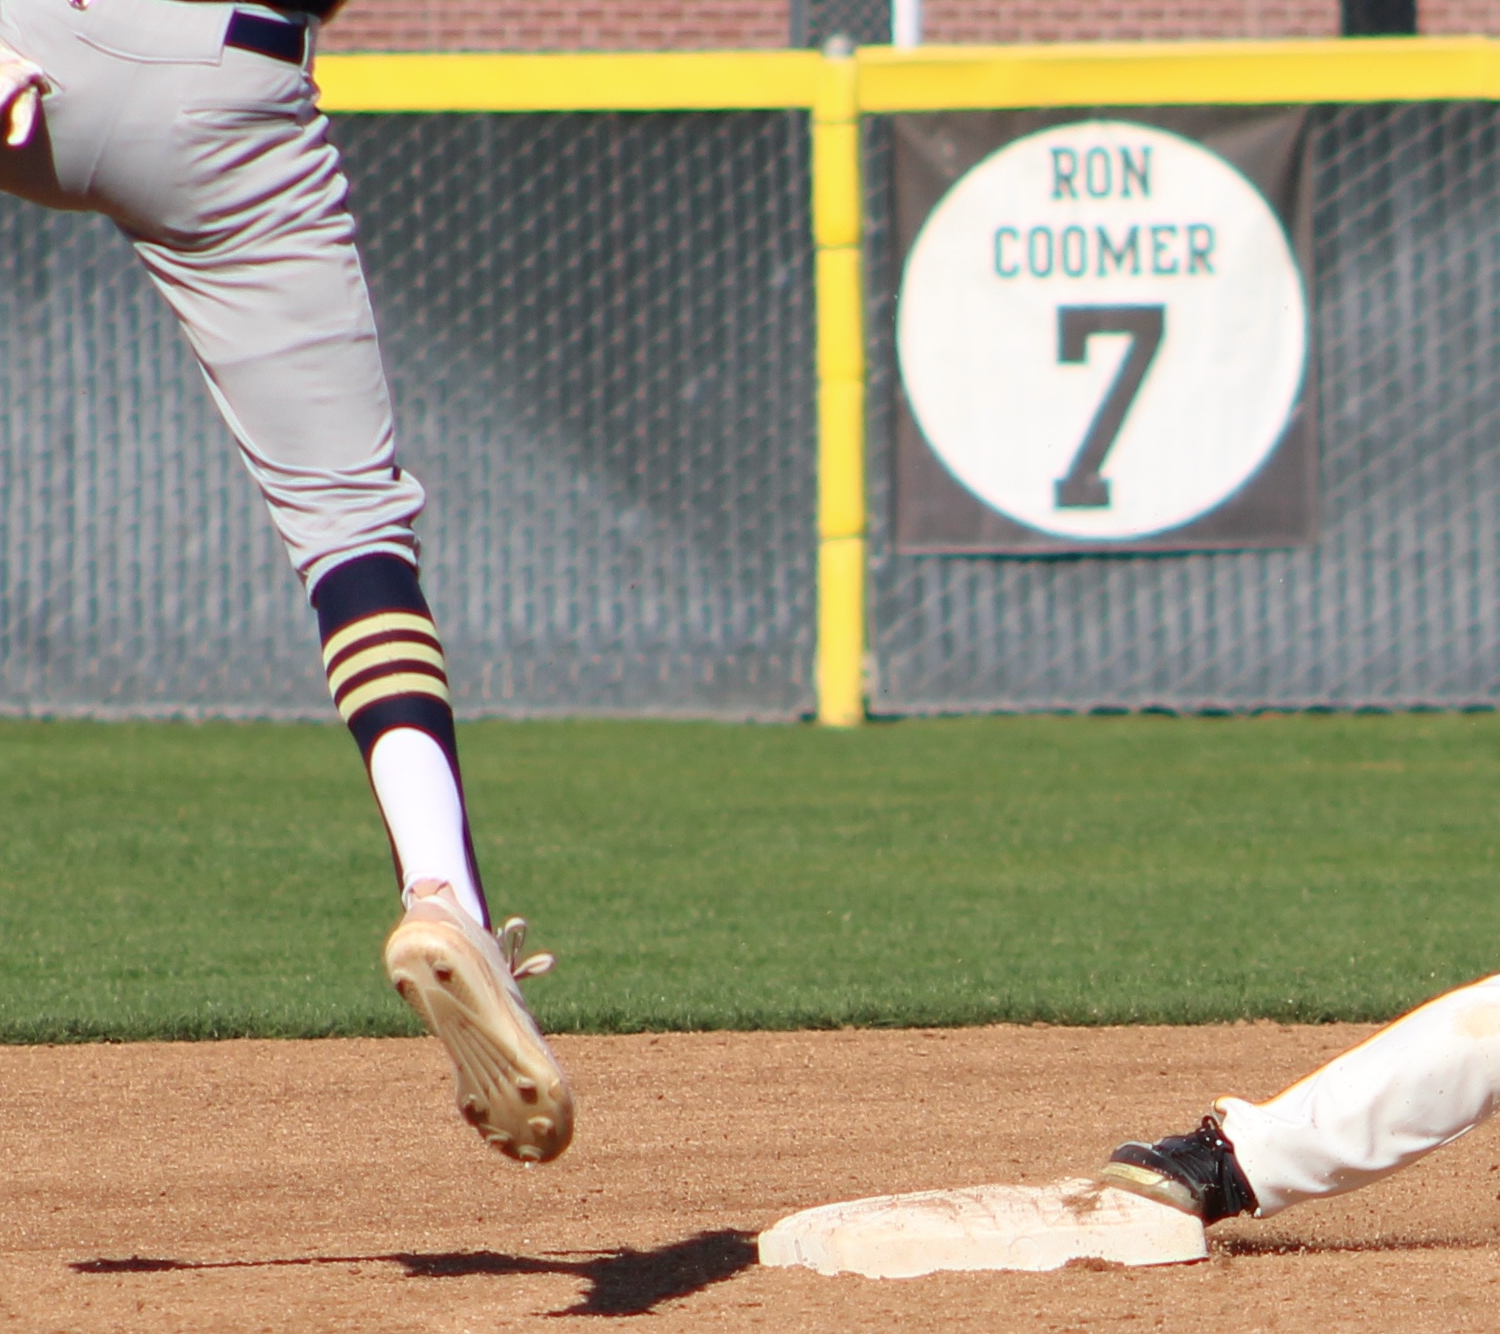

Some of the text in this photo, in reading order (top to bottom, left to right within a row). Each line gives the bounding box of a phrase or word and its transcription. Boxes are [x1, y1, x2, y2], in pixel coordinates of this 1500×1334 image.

[1049, 146, 1153, 200] RON
[993, 223, 1216, 279] COOMER
[1052, 302, 1167, 511] 7
